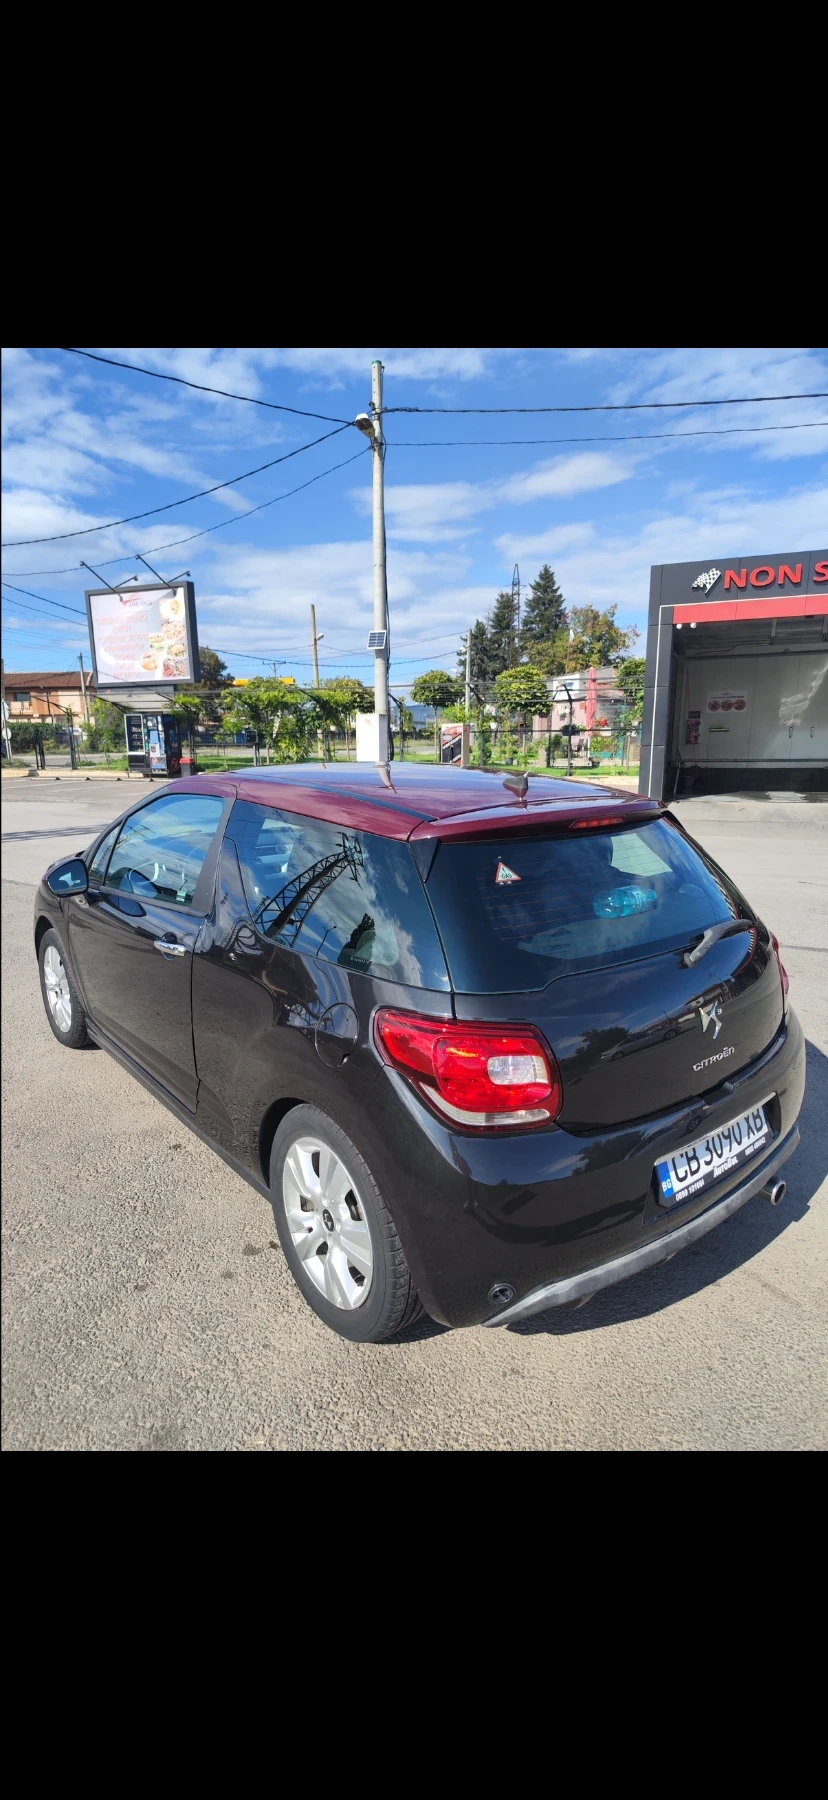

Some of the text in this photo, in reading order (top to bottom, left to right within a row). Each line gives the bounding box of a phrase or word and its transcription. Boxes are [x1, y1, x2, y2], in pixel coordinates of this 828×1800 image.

[724, 563, 802, 589] NON
[671, 1147, 701, 1183] CB
[704, 1122, 743, 1166] 3090
[661, 1179, 672, 1192] BG
